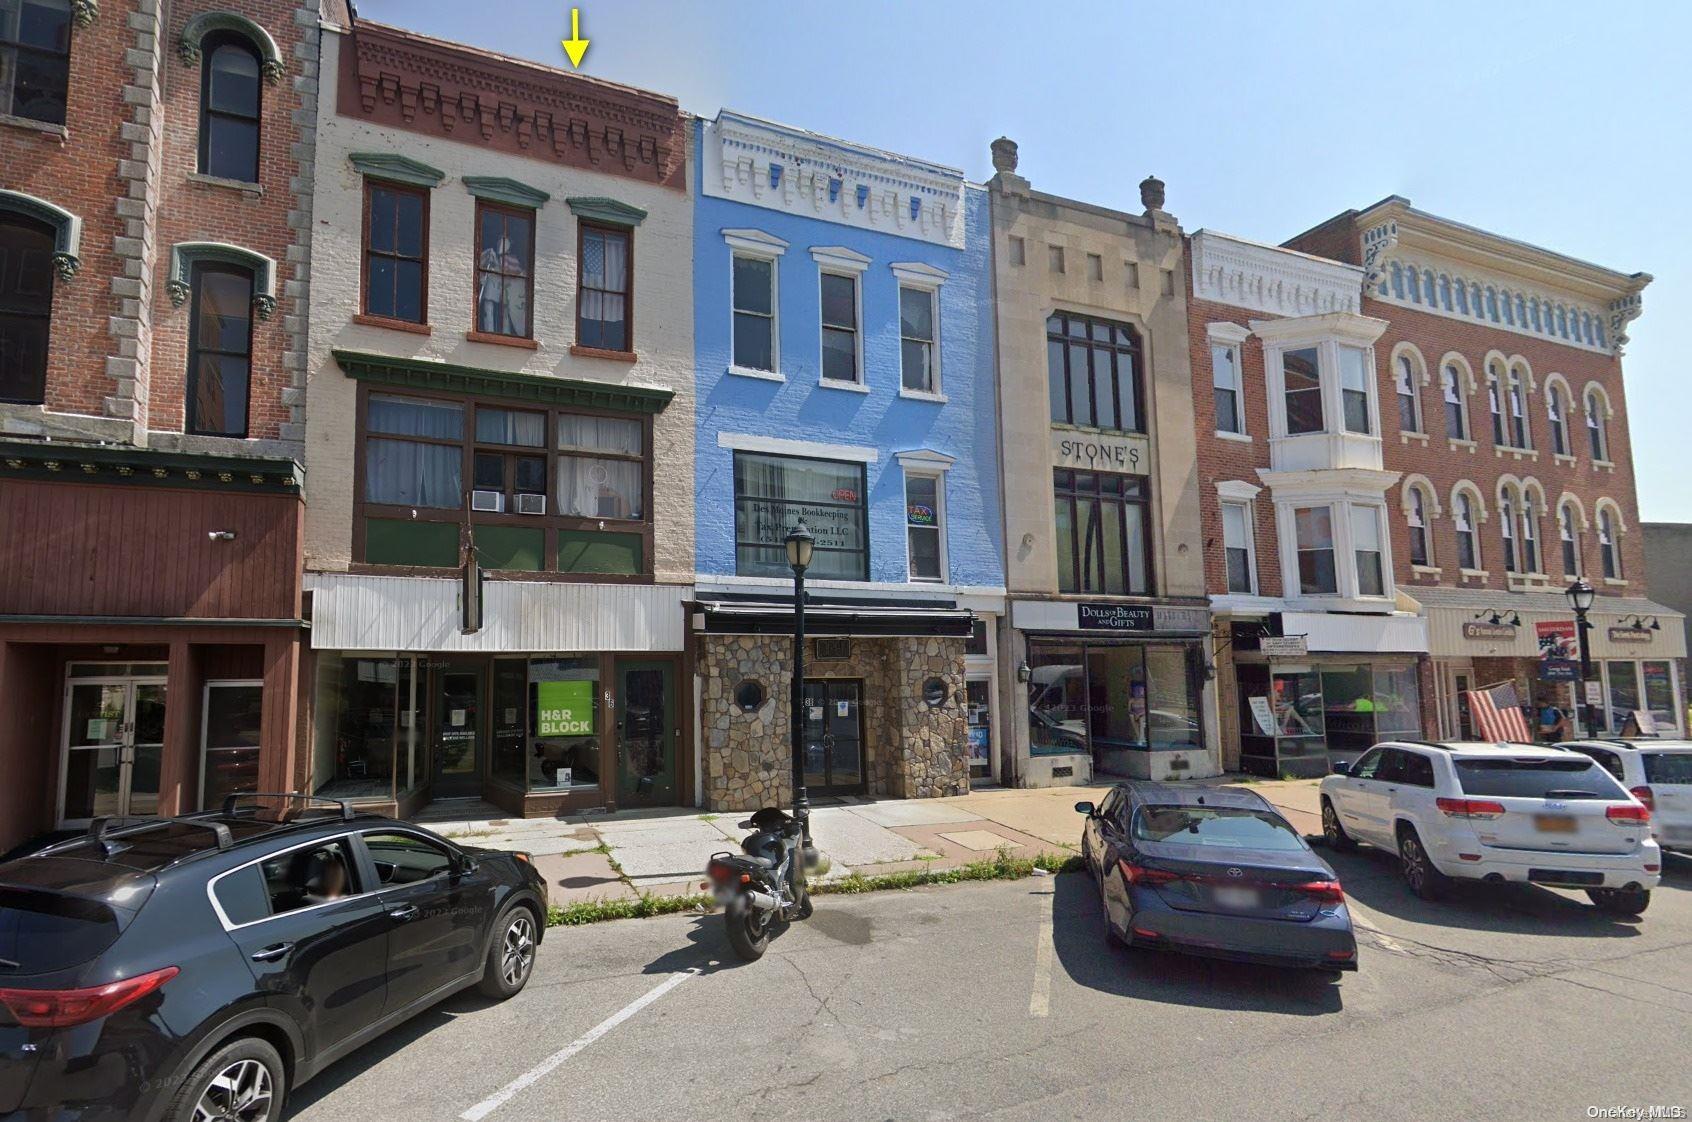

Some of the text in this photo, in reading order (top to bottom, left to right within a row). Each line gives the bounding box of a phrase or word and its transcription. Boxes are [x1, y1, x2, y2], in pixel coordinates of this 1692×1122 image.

[1061, 441, 1139, 463] STONE'S
[832, 488, 857, 502] OPEN
[753, 503, 769, 513] Des
[801, 507, 848, 520] Bookkeeping
[907, 506, 928, 515] TAX
[830, 528, 848, 536] LLC
[1082, 606, 1110, 617] DOLLS
[1117, 607, 1150, 618] BEAUTY
[1110, 616, 1135, 627] GIFTS
[541, 709, 572, 721] H&R
[541, 721, 590, 733] BLOCK
